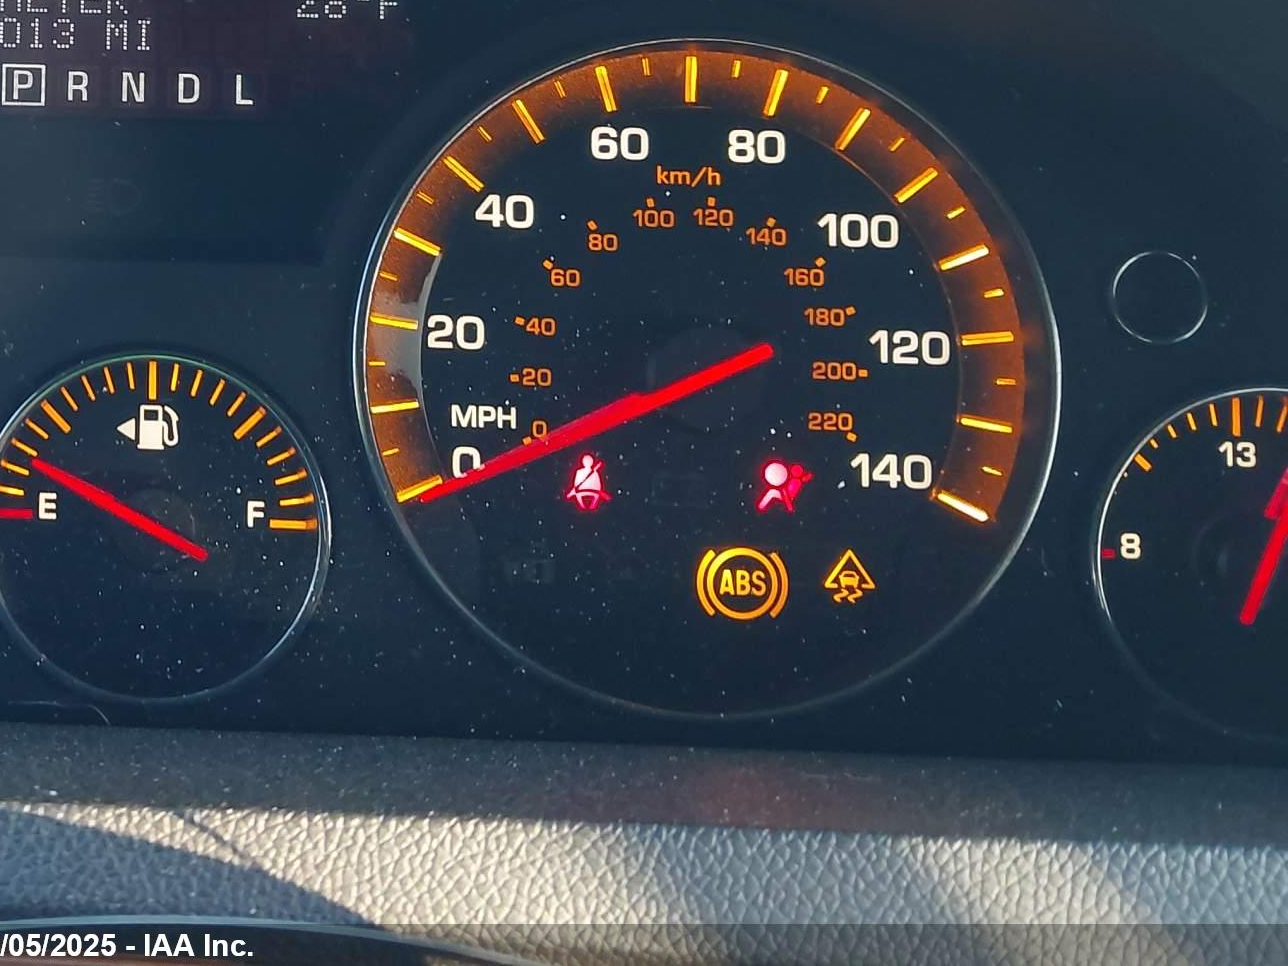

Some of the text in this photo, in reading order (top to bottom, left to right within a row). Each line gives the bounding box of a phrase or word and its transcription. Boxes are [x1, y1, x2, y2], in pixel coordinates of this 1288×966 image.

[107, 20, 150, 50] MI
[13, 70, 253, 104] P R N D L
[591, 127, 648, 160] 60
[728, 130, 785, 163] 80
[657, 166, 720, 187] km/h
[476, 195, 534, 228] 40
[633, 210, 674, 227] 100
[694, 209, 733, 226] 120
[589, 234, 617, 251] 80
[746, 228, 786, 245] 140
[818, 214, 898, 248] 100
[551, 269, 580, 286] 60
[526, 318, 555, 335] 40
[805, 308, 844, 326] 180
[428, 315, 484, 349] 20
[870, 330, 949, 365] 120
[523, 368, 551, 386] 20
[813, 362, 856, 380] 200
[452, 405, 516, 429] MPH
[809, 413, 852, 430] 220
[451, 447, 482, 478] 0
[1219, 442, 1256, 467] 13
[851, 454, 931, 489] 140
[39, 493, 56, 519] E
[248, 501, 264, 527] F
[1121, 533, 1140, 559] 8
[720, 569, 765, 595] ABS
